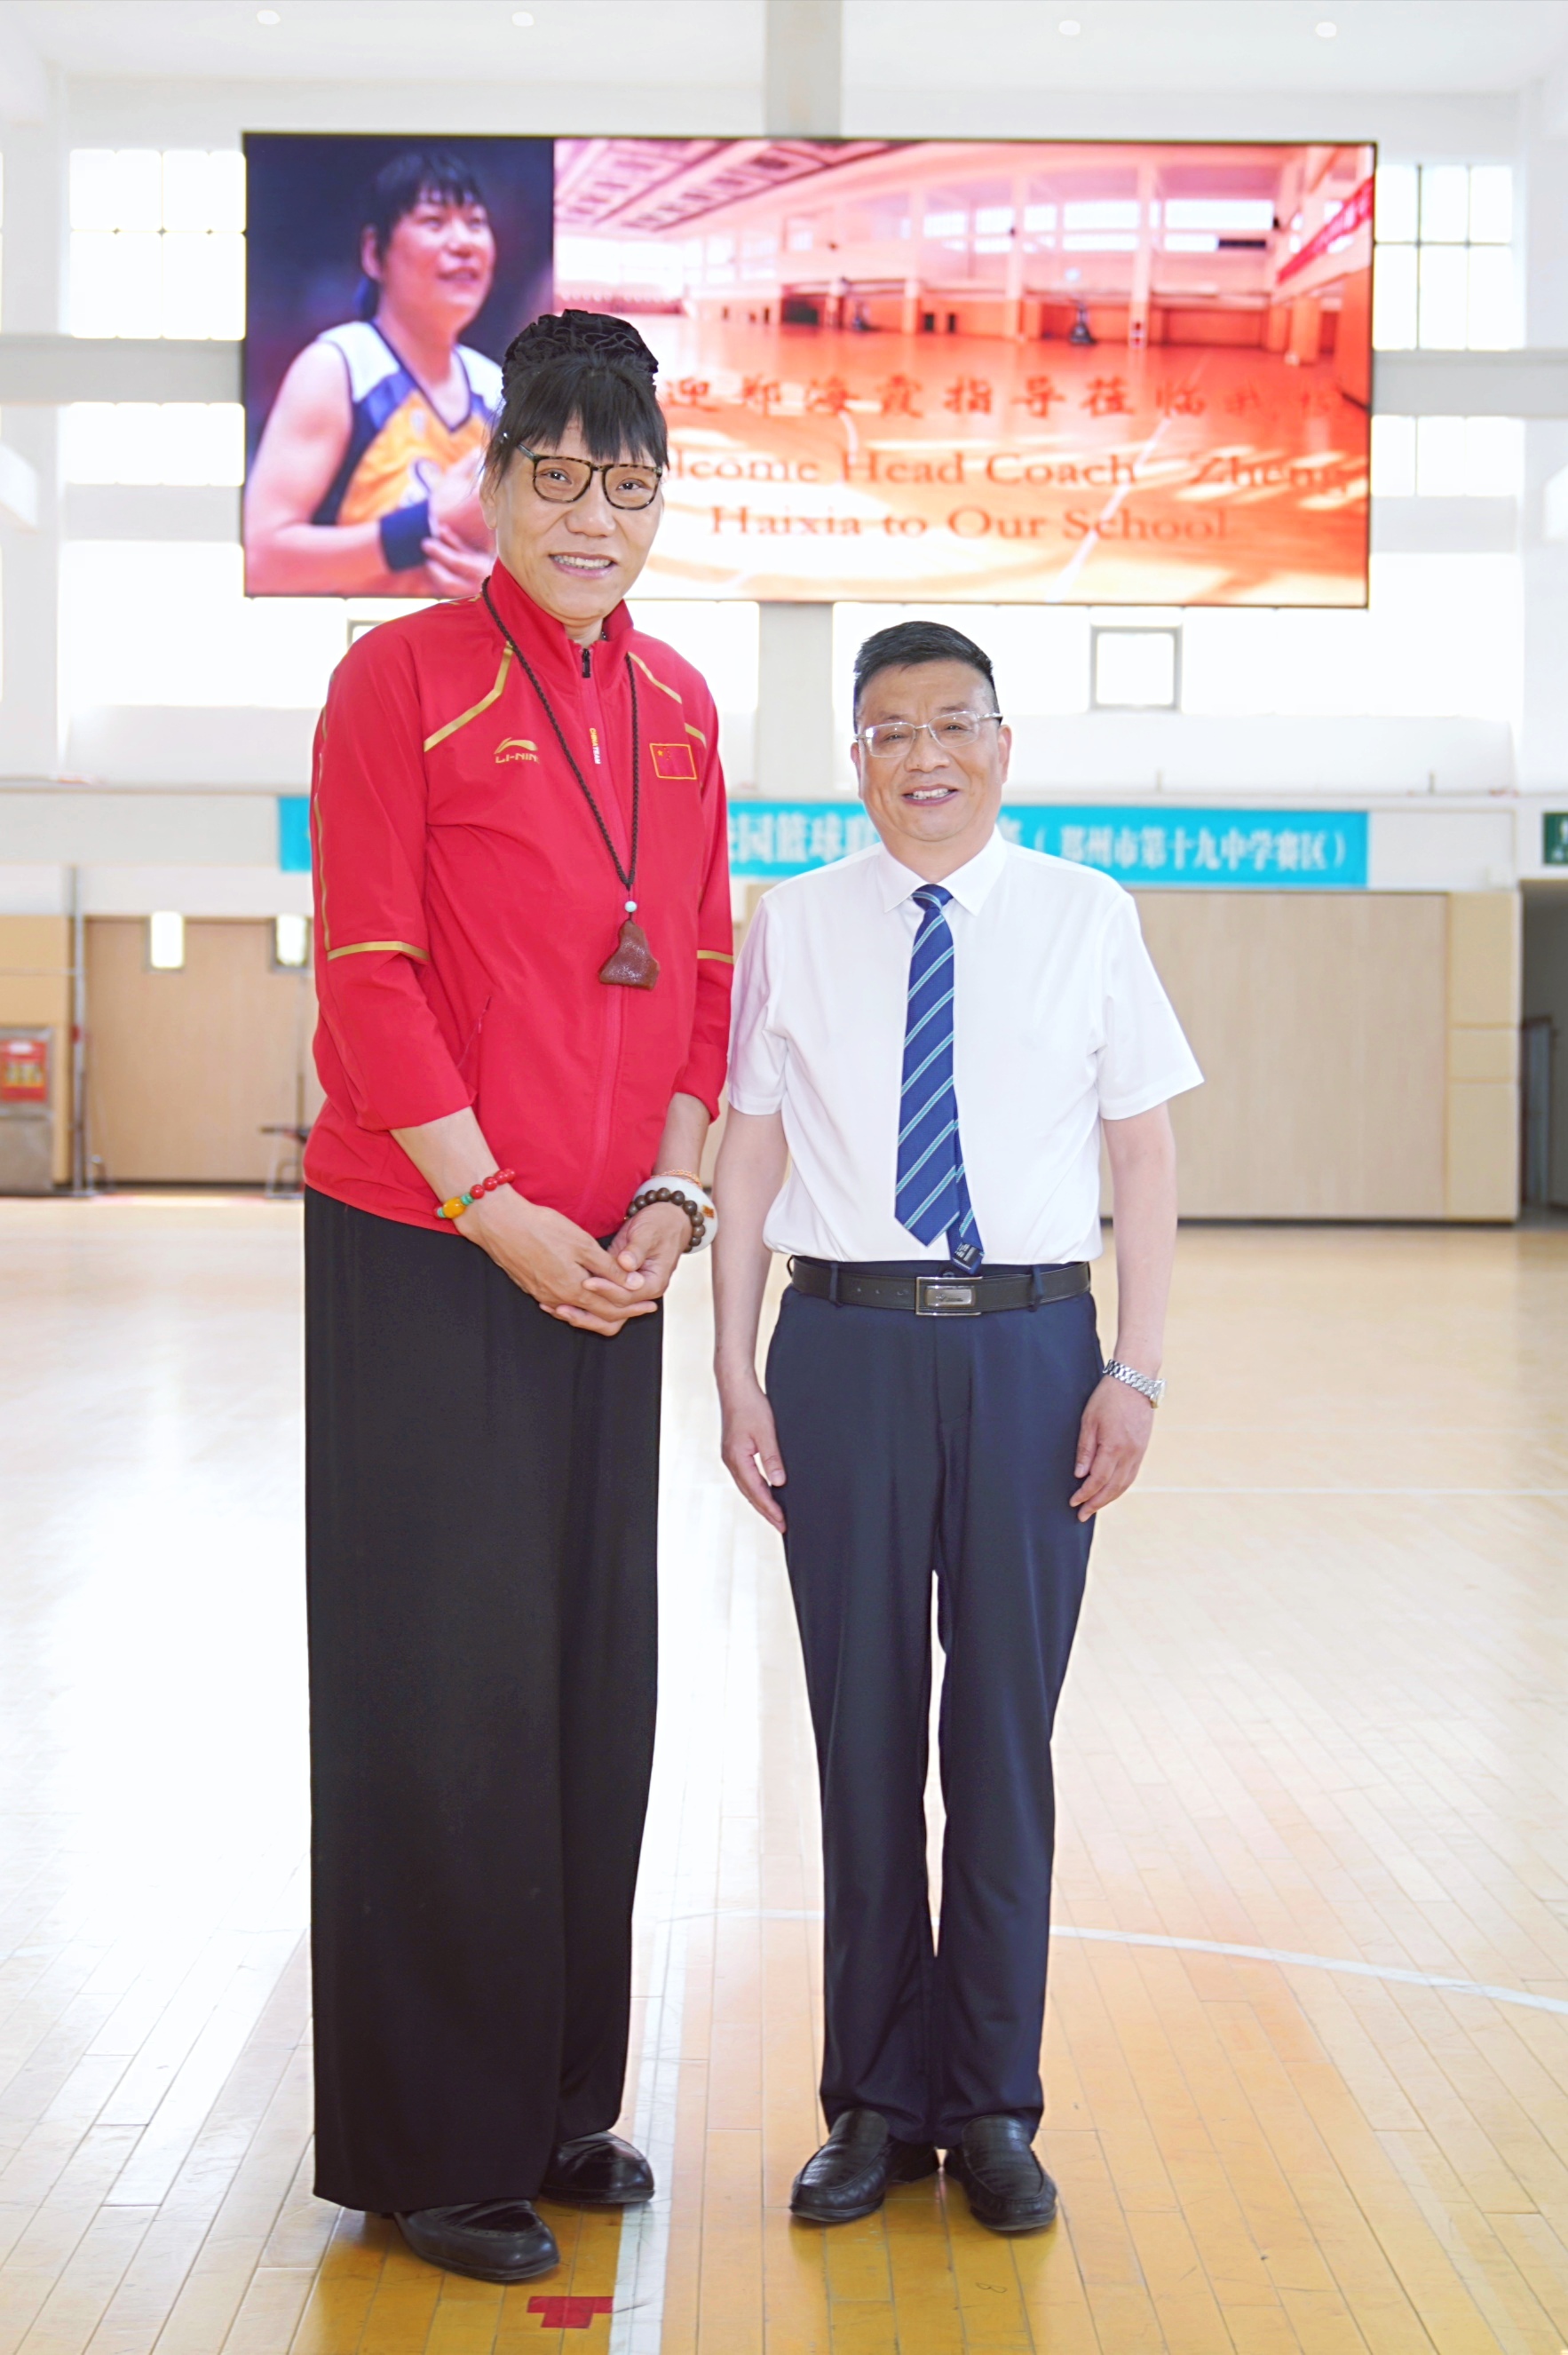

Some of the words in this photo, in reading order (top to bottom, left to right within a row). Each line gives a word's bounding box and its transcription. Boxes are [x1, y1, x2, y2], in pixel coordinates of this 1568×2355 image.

[668, 449, 820, 483] lcome
[841, 446, 965, 485] Head
[986, 452, 1139, 487] Coach
[712, 506, 860, 536] Haixia
[883, 514, 929, 536] to
[947, 505, 1048, 540] Our
[1063, 507, 1228, 540] School
[495, 752, 540, 765] LI-NIN
